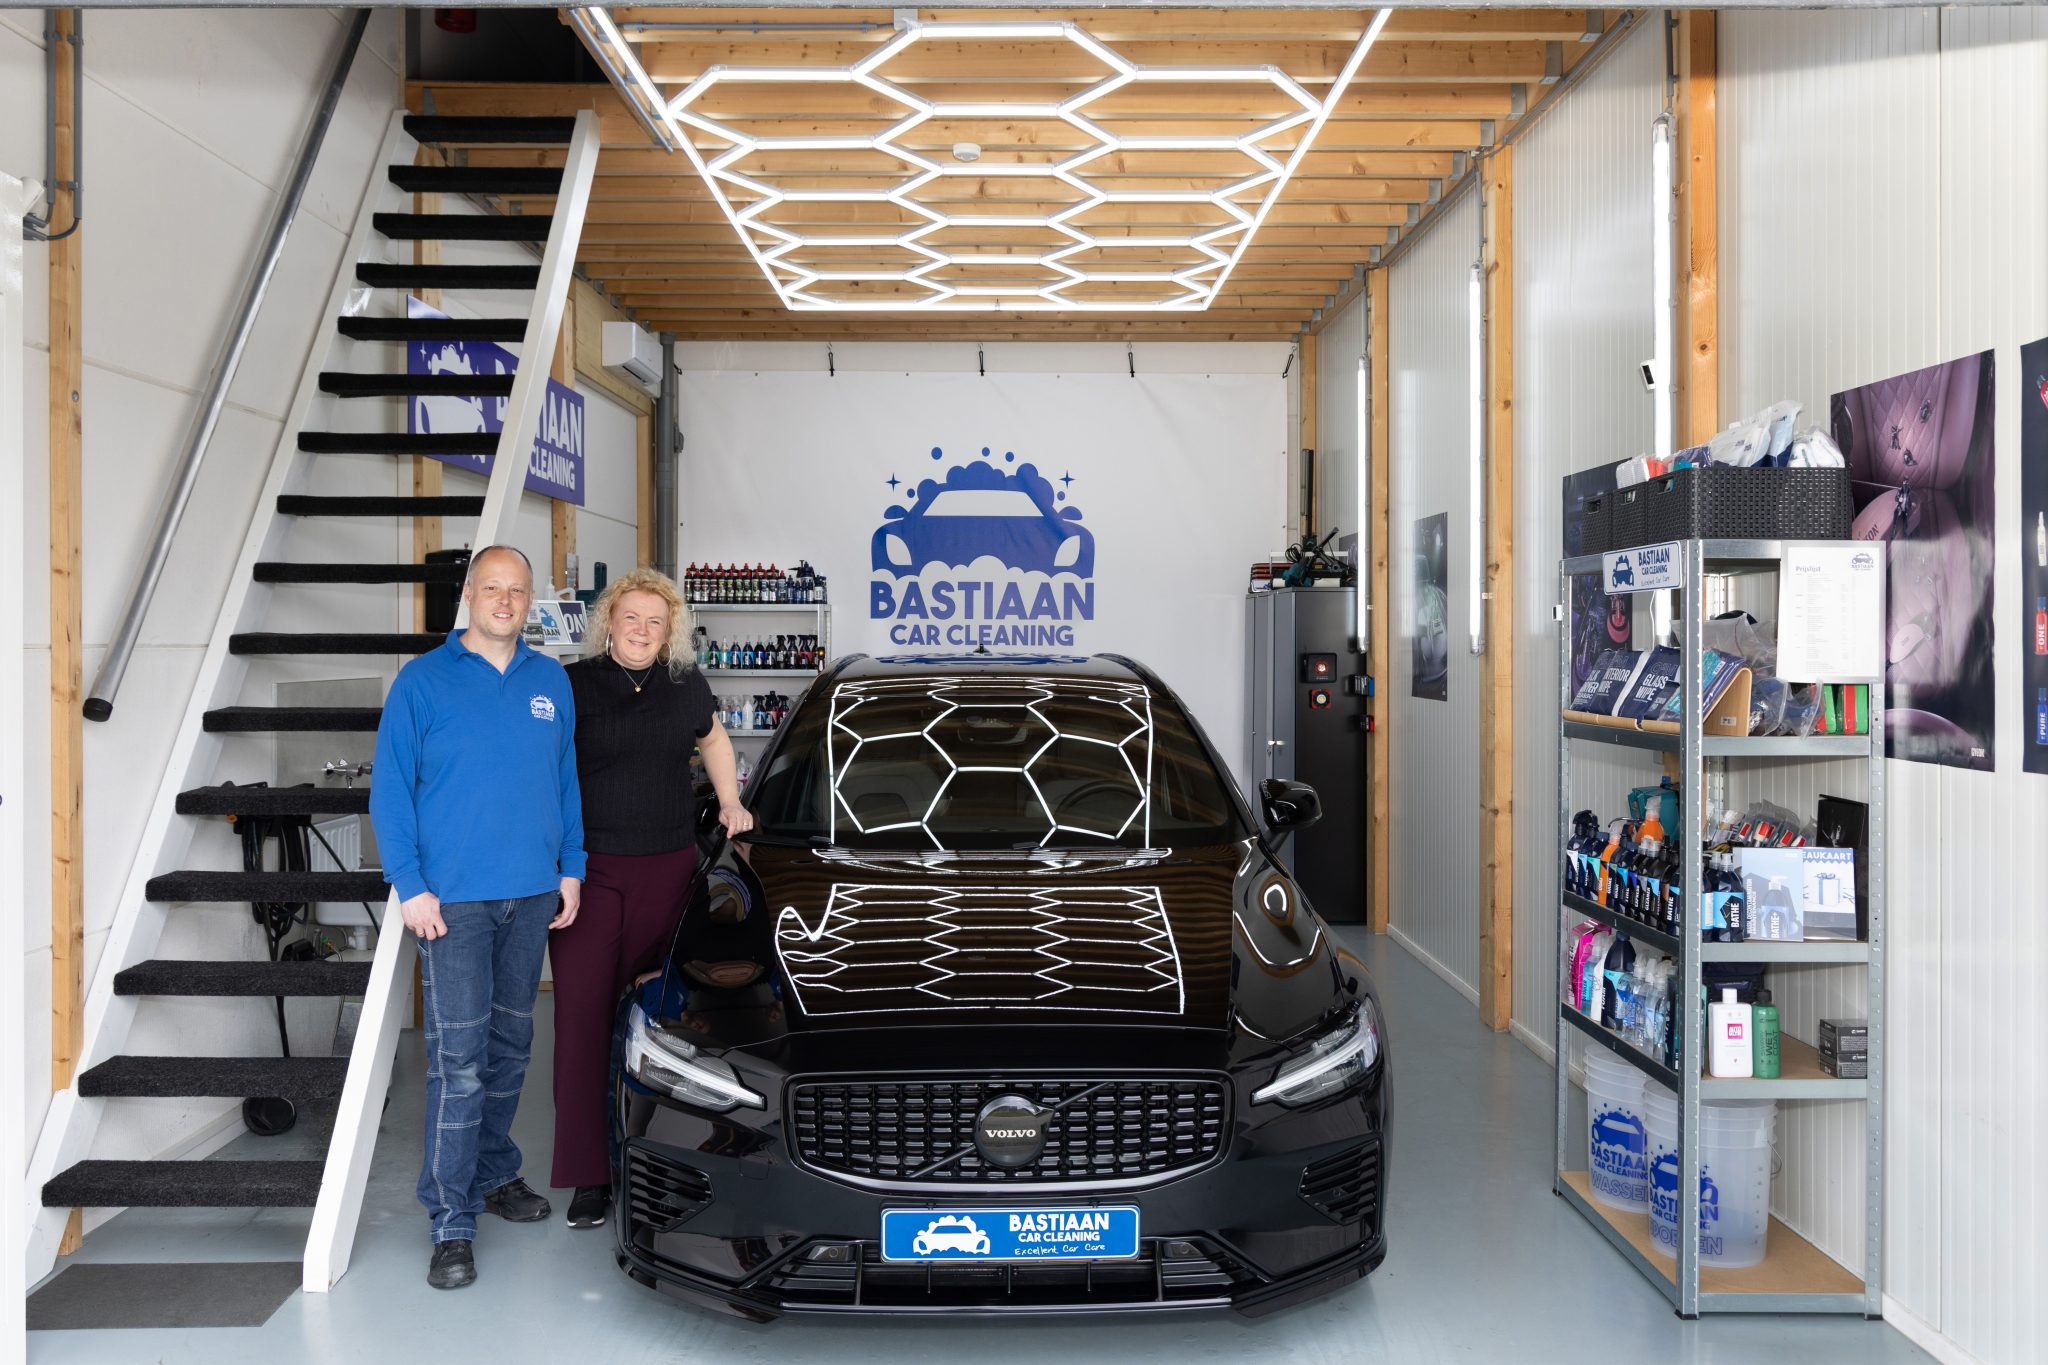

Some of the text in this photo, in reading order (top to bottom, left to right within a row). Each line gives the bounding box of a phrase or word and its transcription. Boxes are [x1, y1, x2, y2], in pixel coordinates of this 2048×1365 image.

[528, 445, 576, 491] CLEANING
[1638, 547, 1671, 566] BASTIAAN
[870, 580, 1095, 620] BASTIAAN
[889, 624, 1074, 646] CAR CLEANING
[1642, 673, 1669, 690] GLASS
[1635, 685, 1657, 701] WIPE
[1802, 851, 1852, 860] EAUKAART
[1666, 896, 1674, 921] BATHE
[1730, 902, 1740, 928] BATHE
[985, 1129, 1036, 1139] VOLVO
[1591, 1141, 1646, 1171] BASTIAA
[1591, 1168, 1648, 1203] WASSE
[1009, 1213, 1110, 1232] BASTIAAN
[1018, 1231, 1100, 1243] CAR CLEANING
[1014, 1243, 1106, 1256] Excellent Car Care
